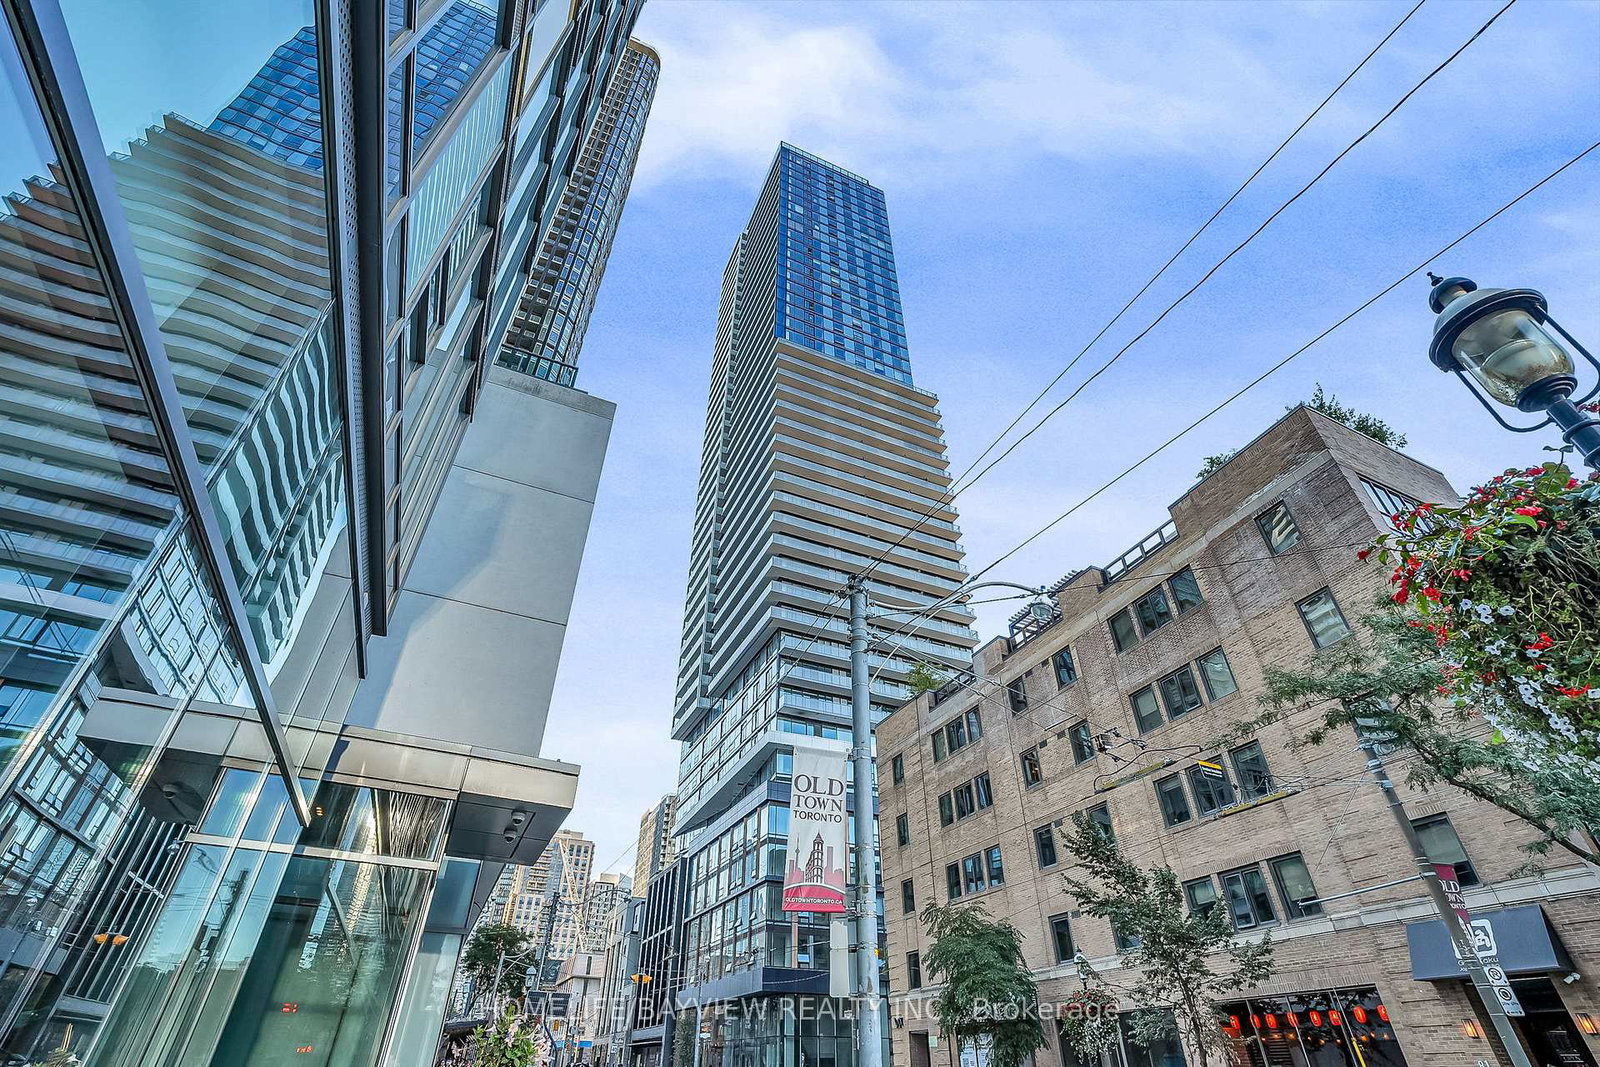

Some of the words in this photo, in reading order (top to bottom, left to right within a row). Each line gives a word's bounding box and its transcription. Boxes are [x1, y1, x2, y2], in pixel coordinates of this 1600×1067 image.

[794, 774, 844, 797] OLD
[794, 794, 843, 812] TOWN
[793, 809, 842, 823] TORONTO
